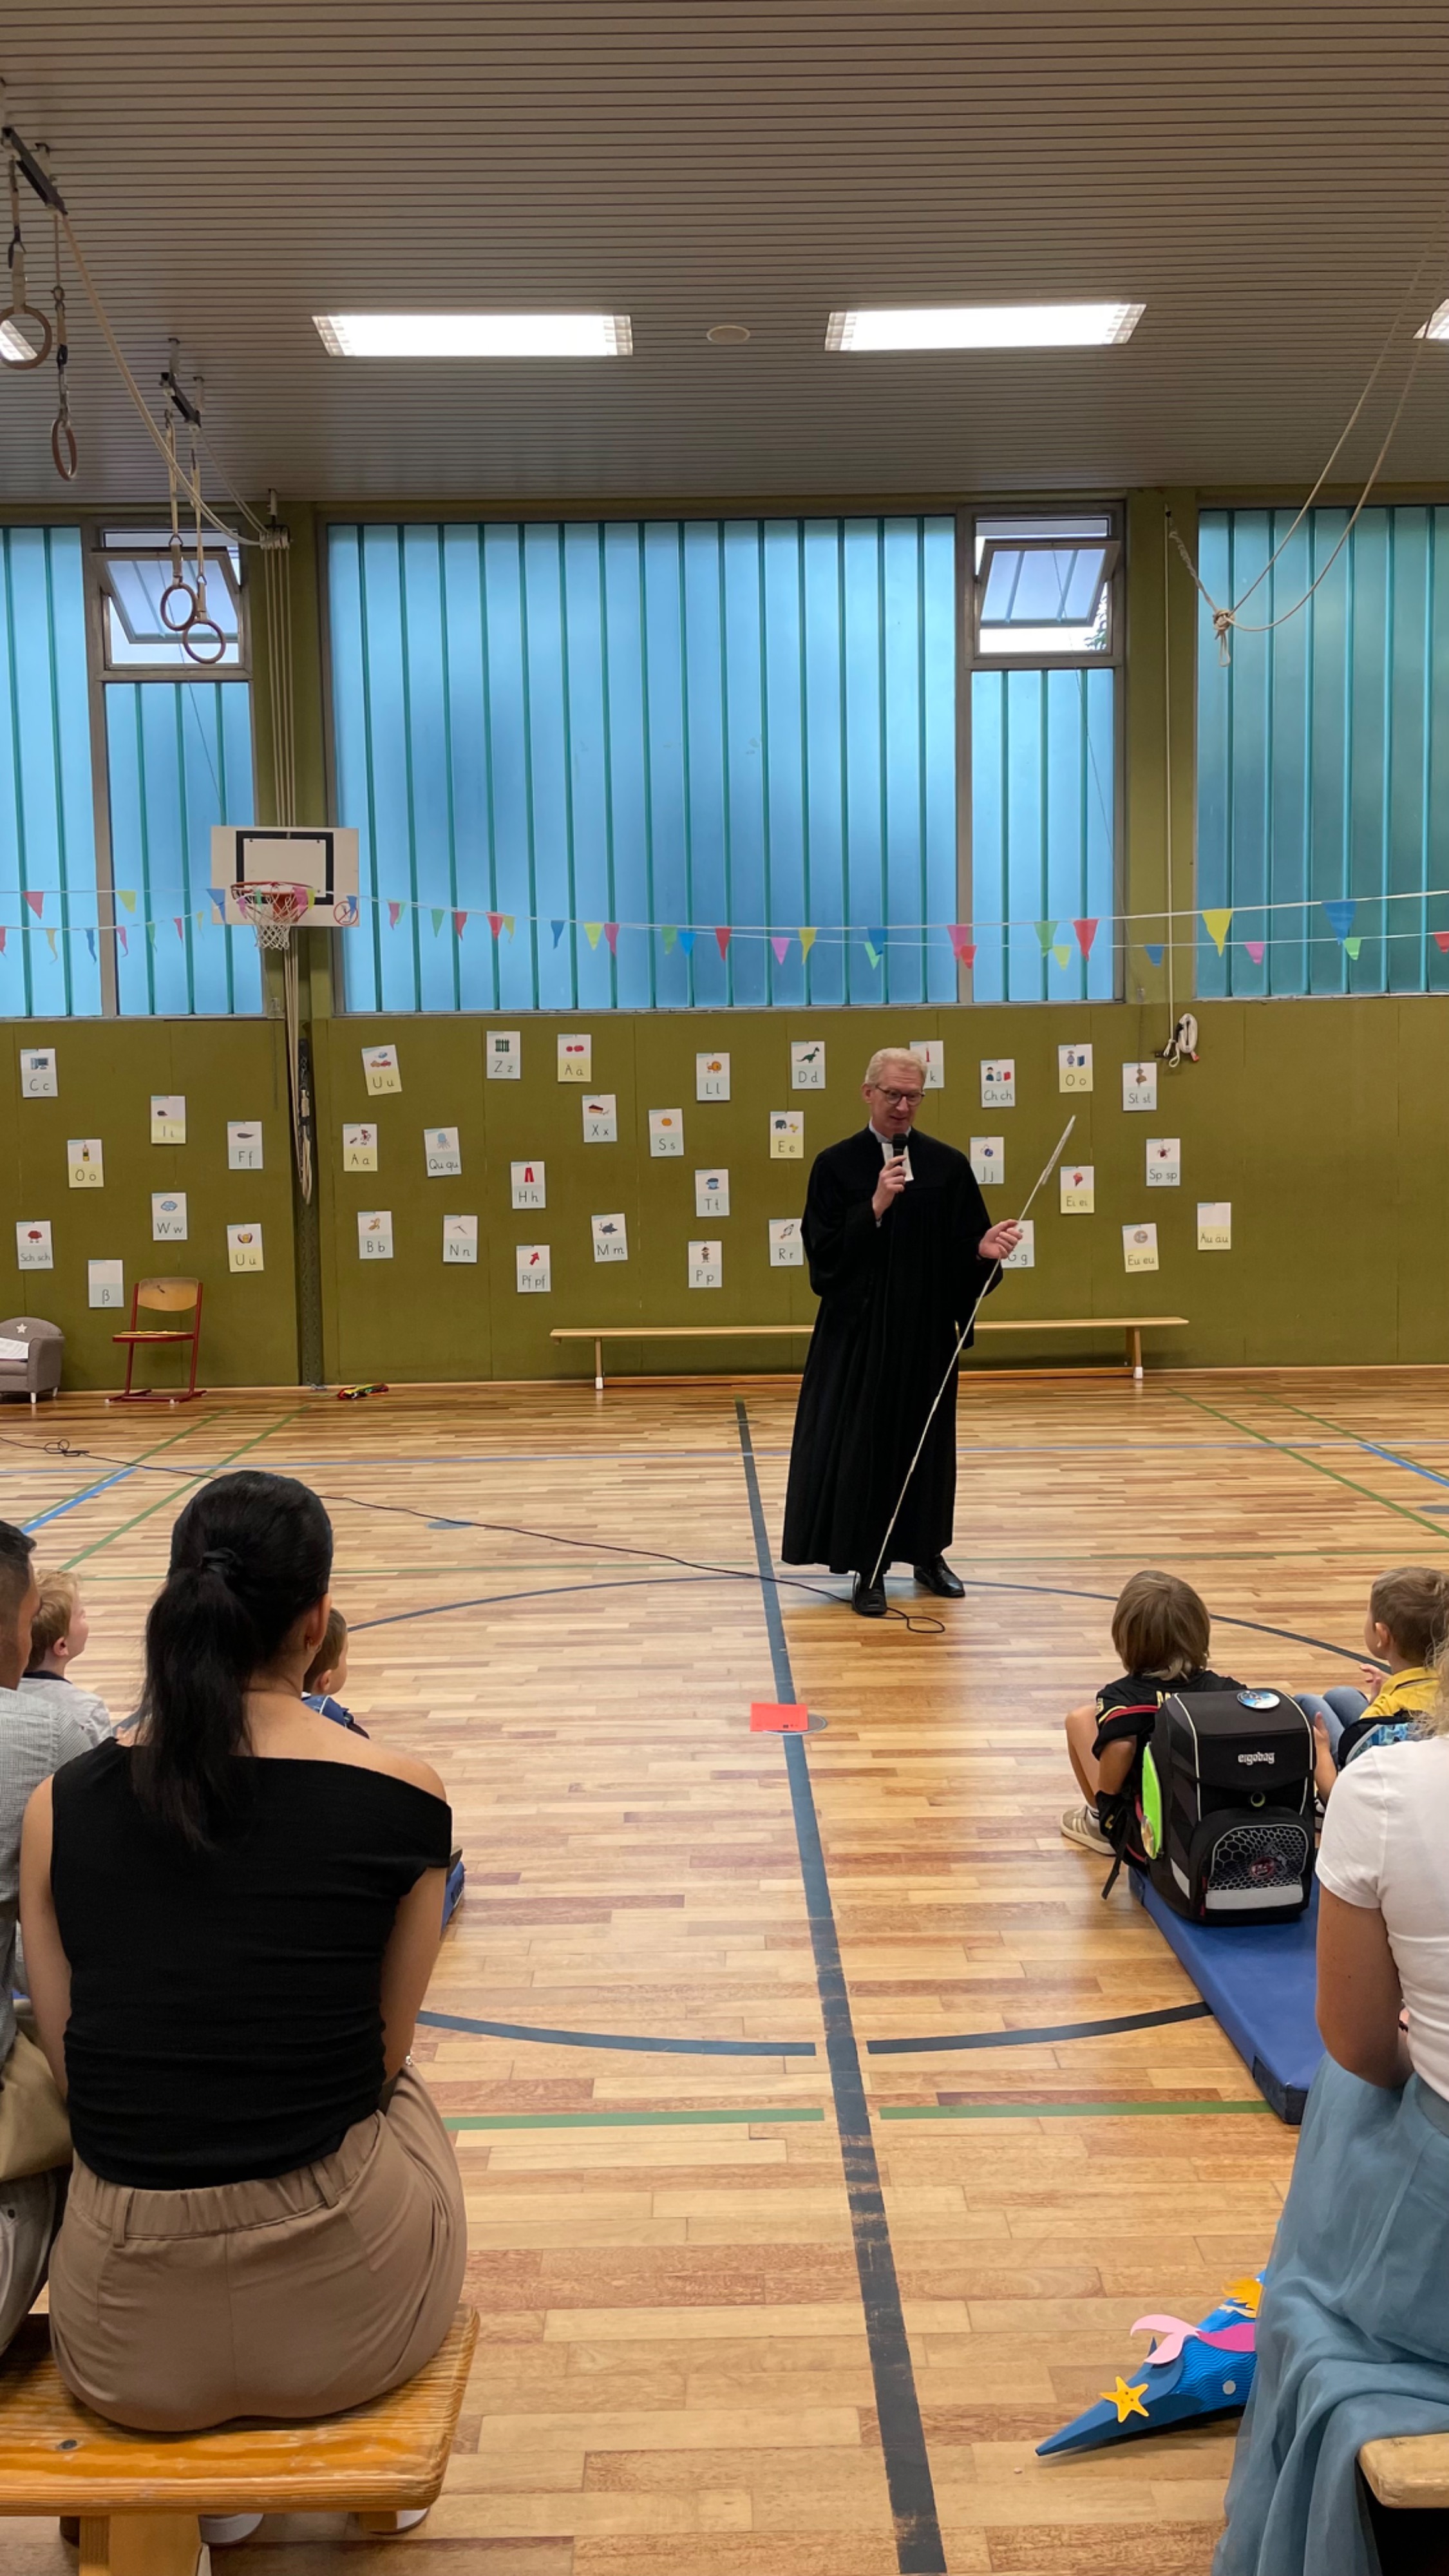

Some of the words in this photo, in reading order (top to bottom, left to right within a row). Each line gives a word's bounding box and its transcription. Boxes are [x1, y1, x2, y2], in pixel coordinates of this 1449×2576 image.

[799, 1070, 807, 1083] D
[811, 1072, 818, 1083] d
[983, 1090, 998, 1101] Ch
[1000, 1090, 1012, 1101] ch
[429, 1159, 443, 1170] Qu
[1149, 1169, 1162, 1182] Sp
[1166, 1171, 1177, 1182] sp
[518, 1191, 527, 1202] H
[531, 1191, 538, 1202] h
[705, 1198, 712, 1210] T
[157, 1223, 171, 1234] W
[366, 1240, 374, 1253] B
[378, 1241, 385, 1253] b
[450, 1244, 459, 1256] N
[597, 1245, 609, 1256] M
[779, 1248, 786, 1260] R
[696, 1270, 703, 1282] P
[1238, 1752, 1274, 1765] ergobag
